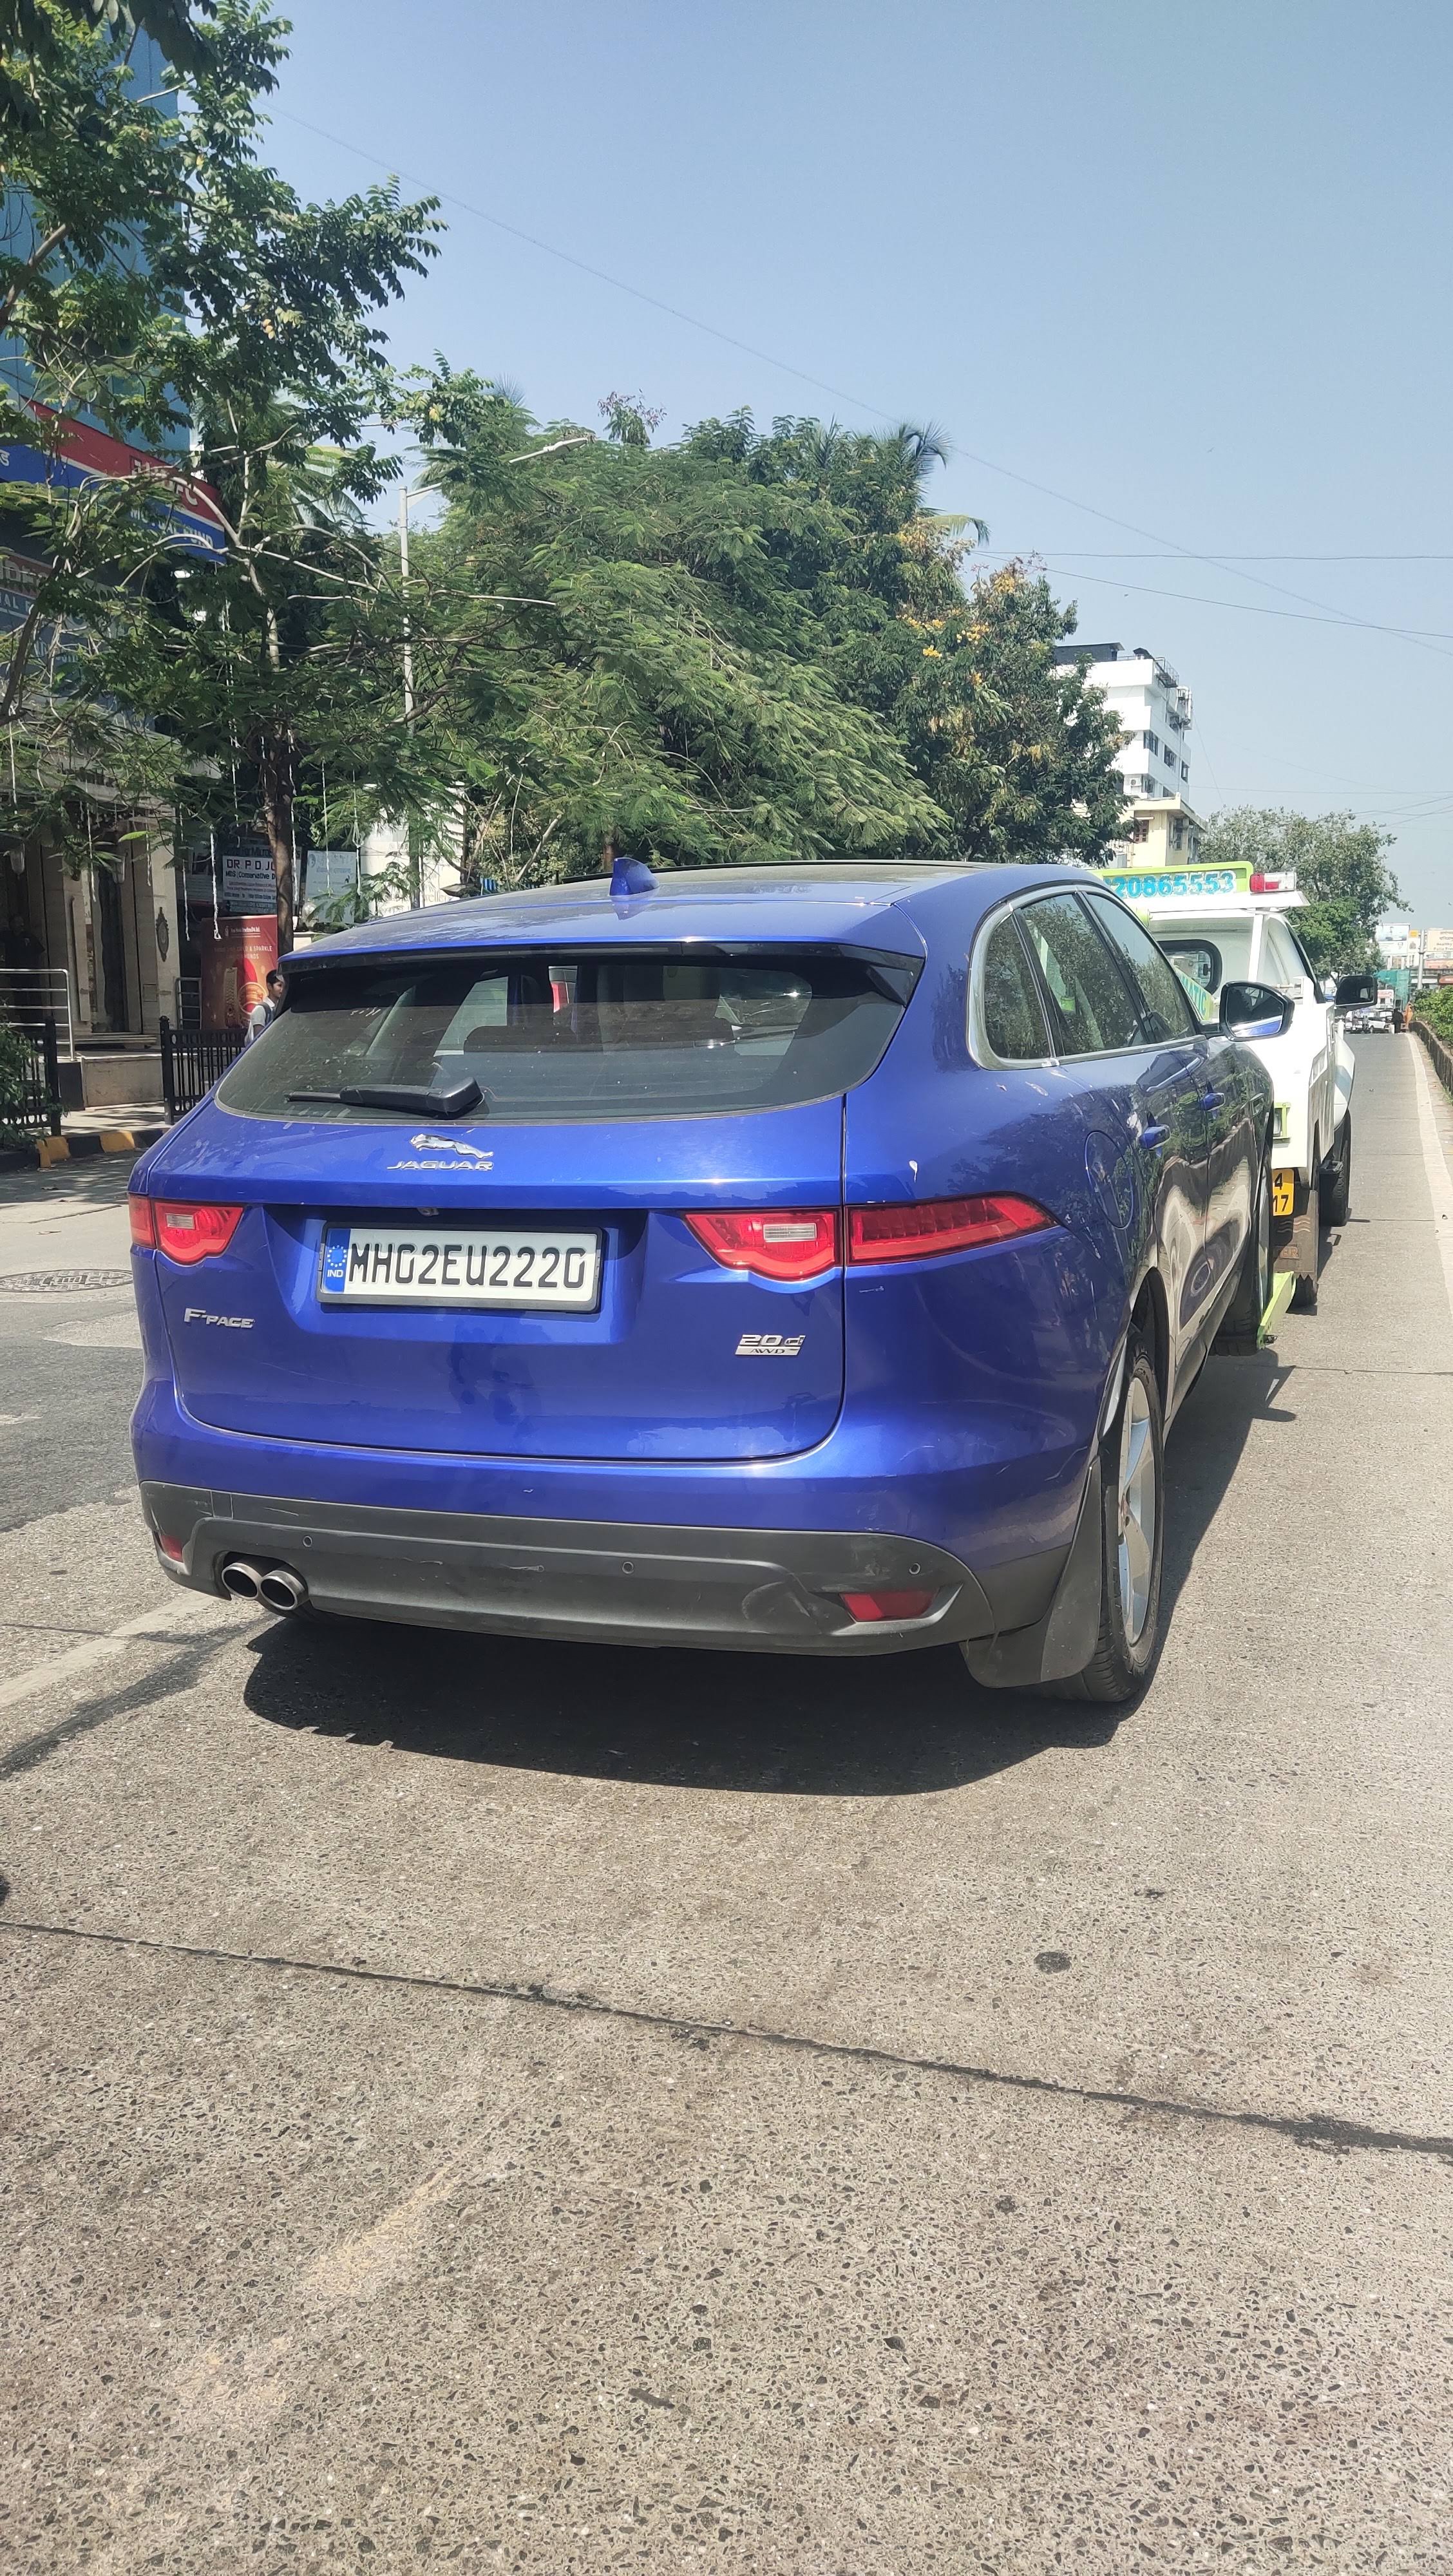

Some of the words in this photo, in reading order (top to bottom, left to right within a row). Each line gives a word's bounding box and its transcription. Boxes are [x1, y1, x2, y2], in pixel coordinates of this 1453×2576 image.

[386, 1160, 494, 1171] JAGUAR
[327, 1269, 343, 1278] IND
[348, 1242, 586, 1289] MH02EU2220
[184, 1307, 255, 1328] F-PACE
